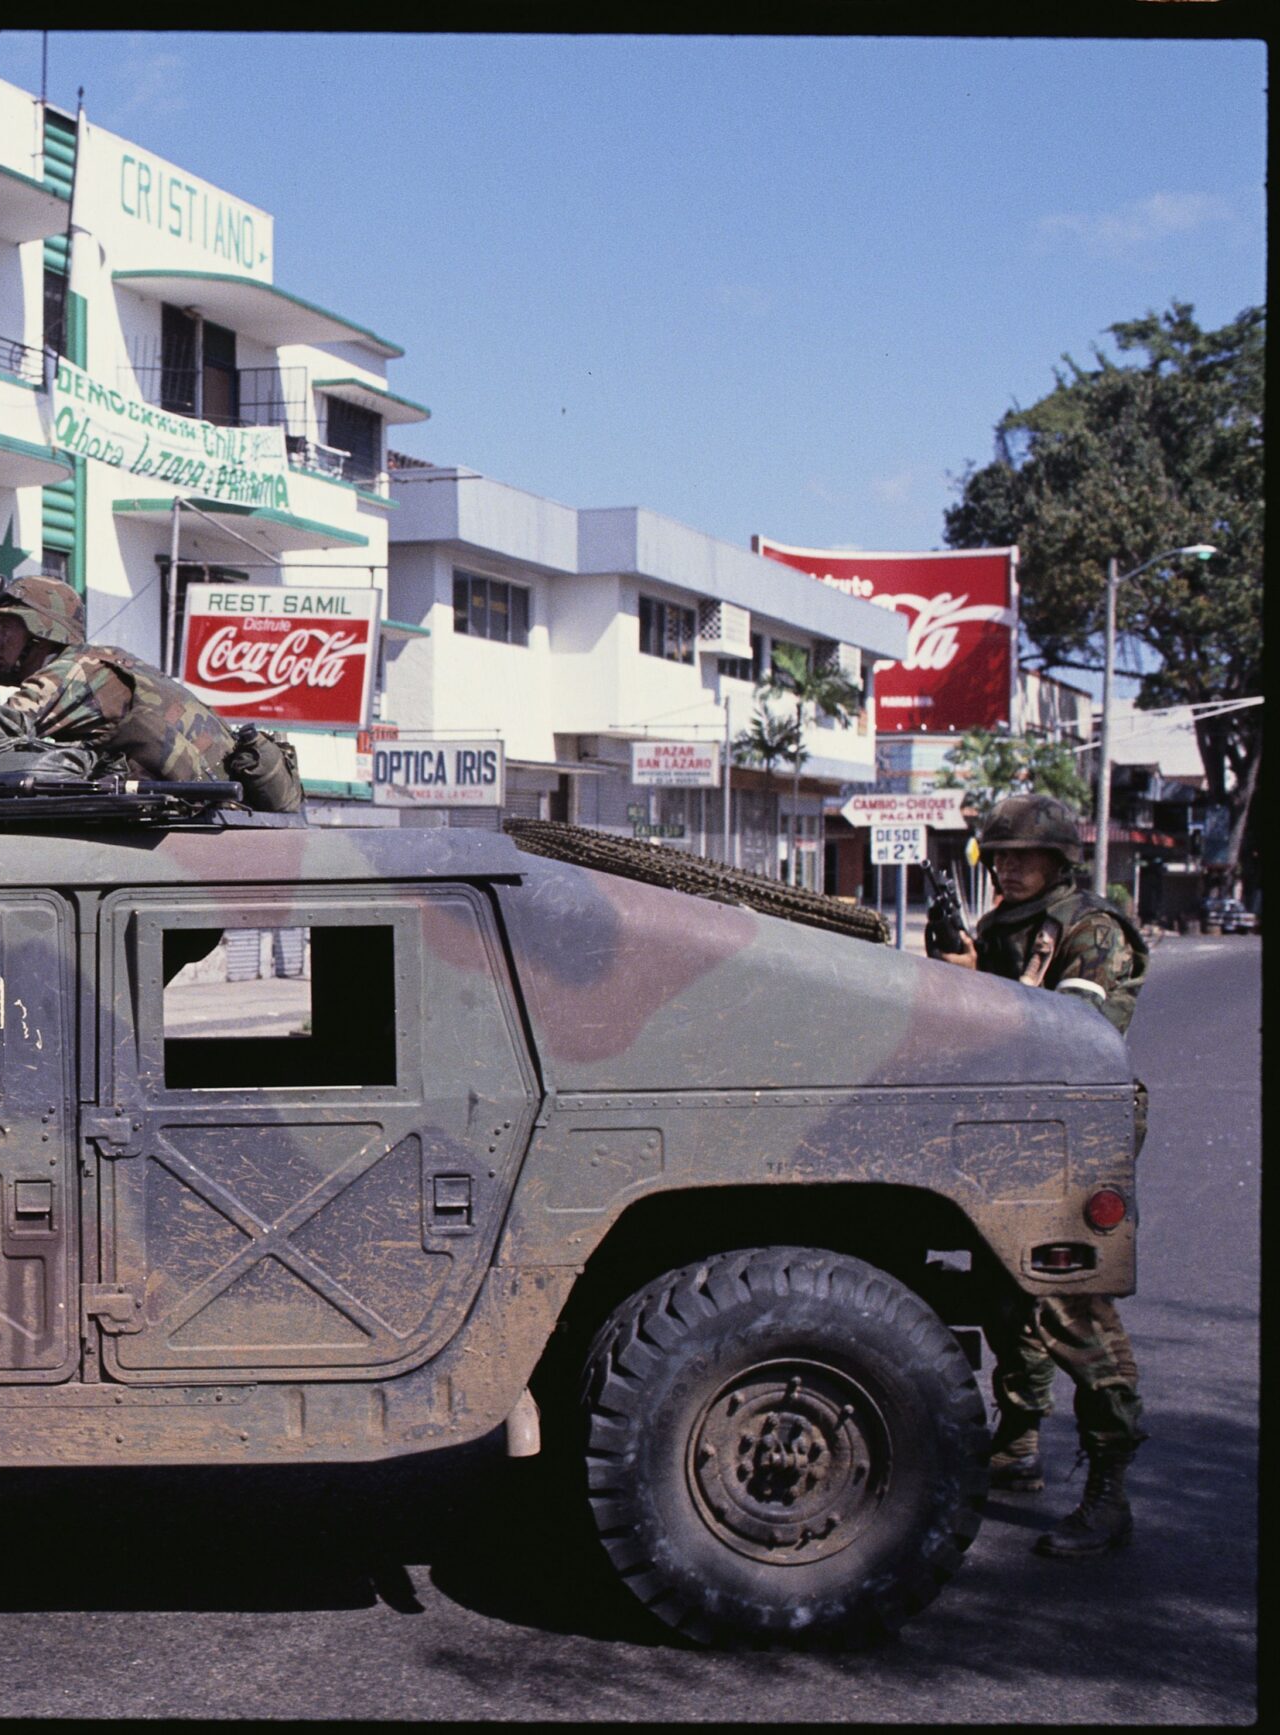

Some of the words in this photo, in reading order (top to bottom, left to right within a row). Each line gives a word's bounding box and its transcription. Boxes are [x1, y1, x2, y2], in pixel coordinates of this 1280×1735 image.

[120, 154, 254, 269] CRISTIANO
[208, 593, 273, 613] REST.
[283, 594, 352, 616] SAMIL
[243, 617, 293, 633] Disfrute
[197, 625, 358, 689] Coca-Cola
[654, 746, 694, 757] BAZAR
[375, 751, 447, 785] OPTICA
[456, 750, 497, 785] IRIS
[637, 759, 660, 769] SAN
[664, 759, 712, 770] LAZARO
[853, 799, 897, 810] CAMBIO
[906, 799, 955, 810] CHEQUES
[876, 829, 920, 843] DESDE
